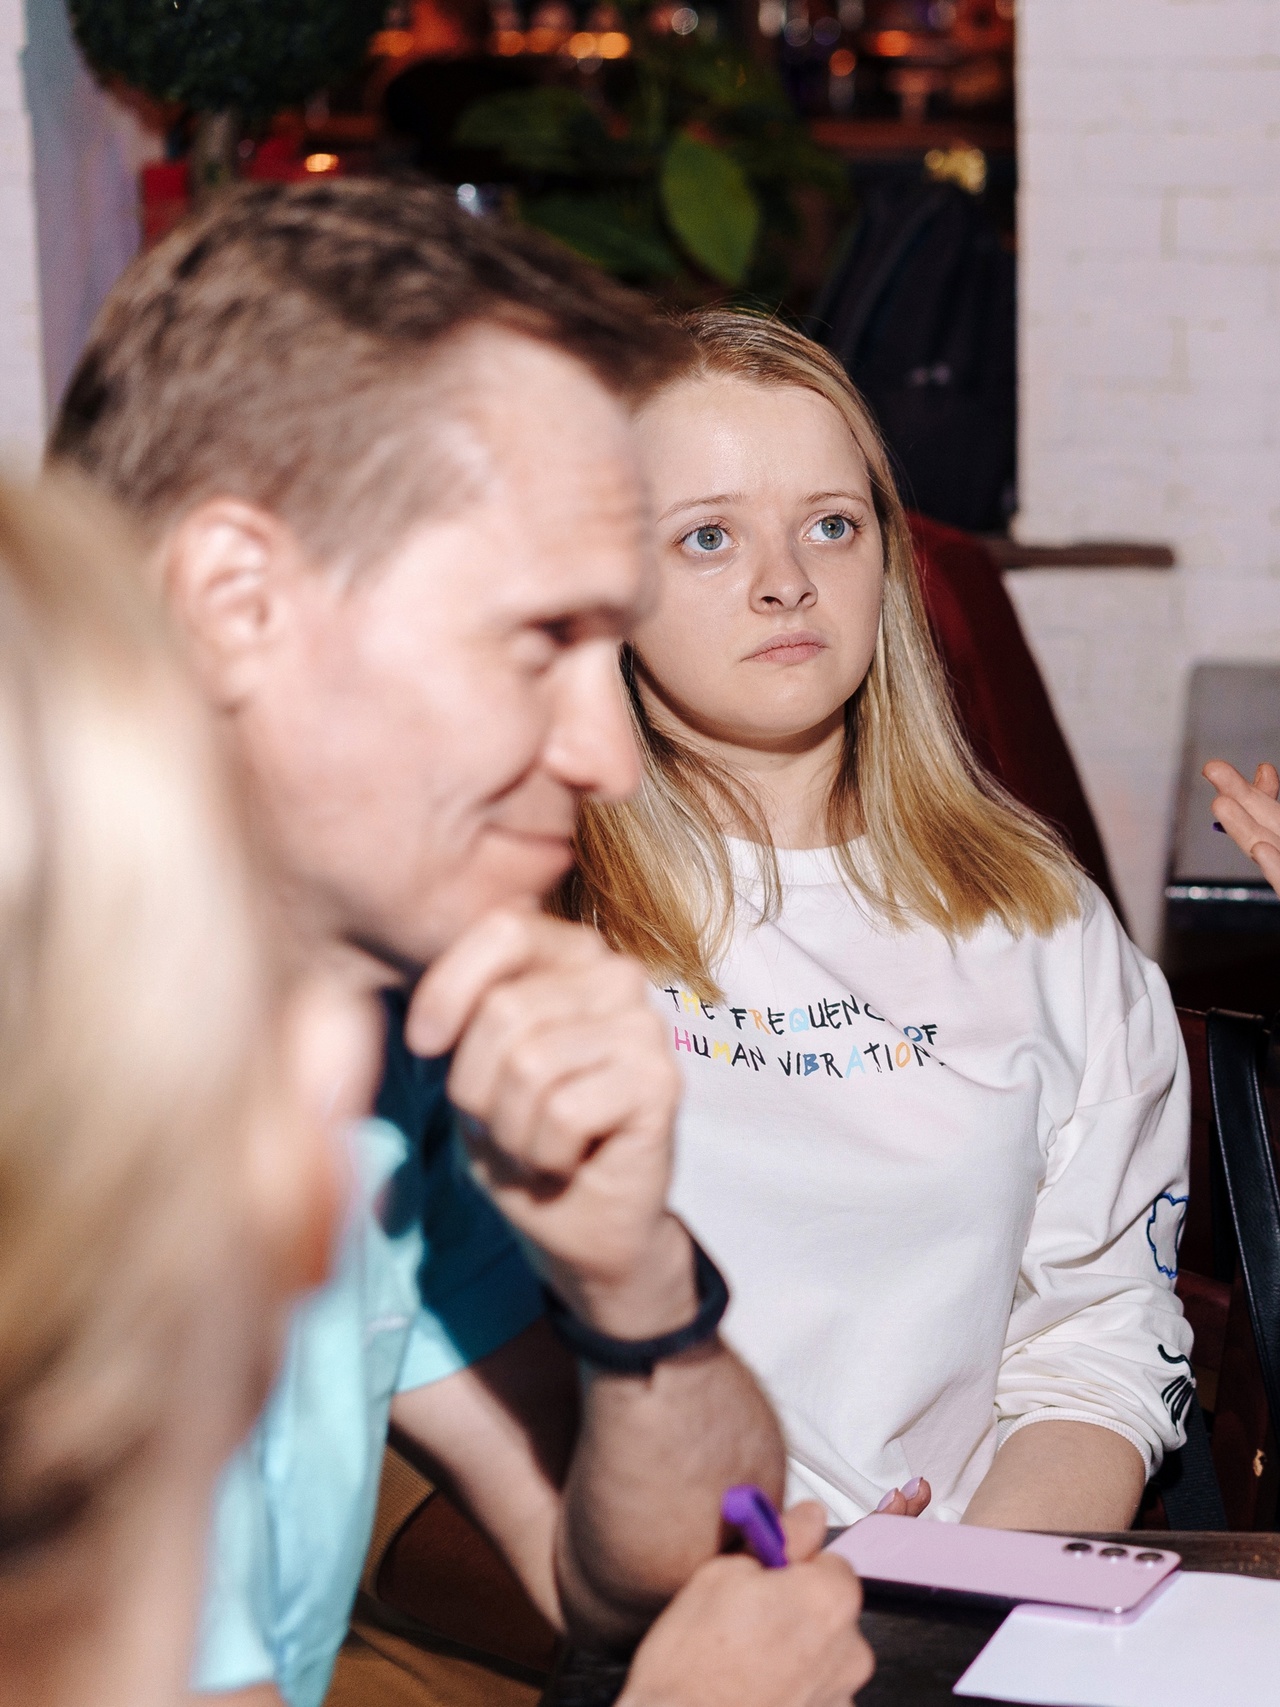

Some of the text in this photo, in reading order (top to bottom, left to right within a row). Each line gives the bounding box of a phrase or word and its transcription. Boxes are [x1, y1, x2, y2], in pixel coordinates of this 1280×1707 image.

[664, 986, 938, 1046] THE FREQUENC OF
[674, 1025, 767, 1072] HUMAN
